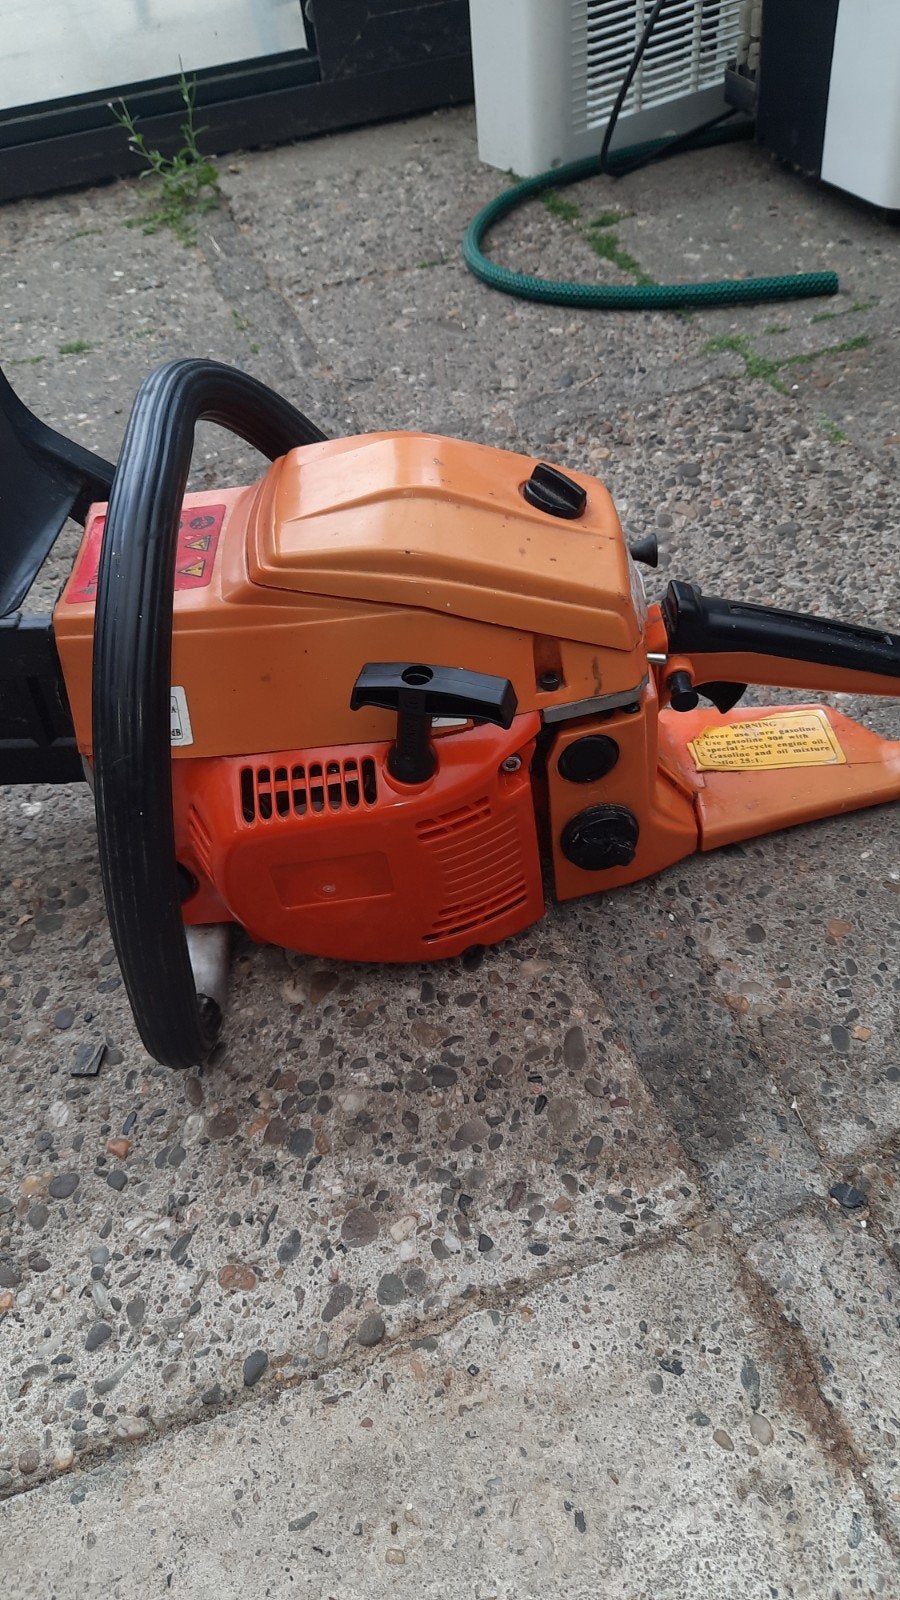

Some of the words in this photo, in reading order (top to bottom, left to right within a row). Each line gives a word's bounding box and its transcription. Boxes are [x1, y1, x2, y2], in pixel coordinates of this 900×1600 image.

[729, 722, 777, 730] WARNING
[725, 737, 764, 746] gasoline
[707, 745, 738, 753] special
[740, 743, 773, 751] 2-cycle
[777, 740, 808, 748] engine
[709, 750, 751, 759] Gasoline
